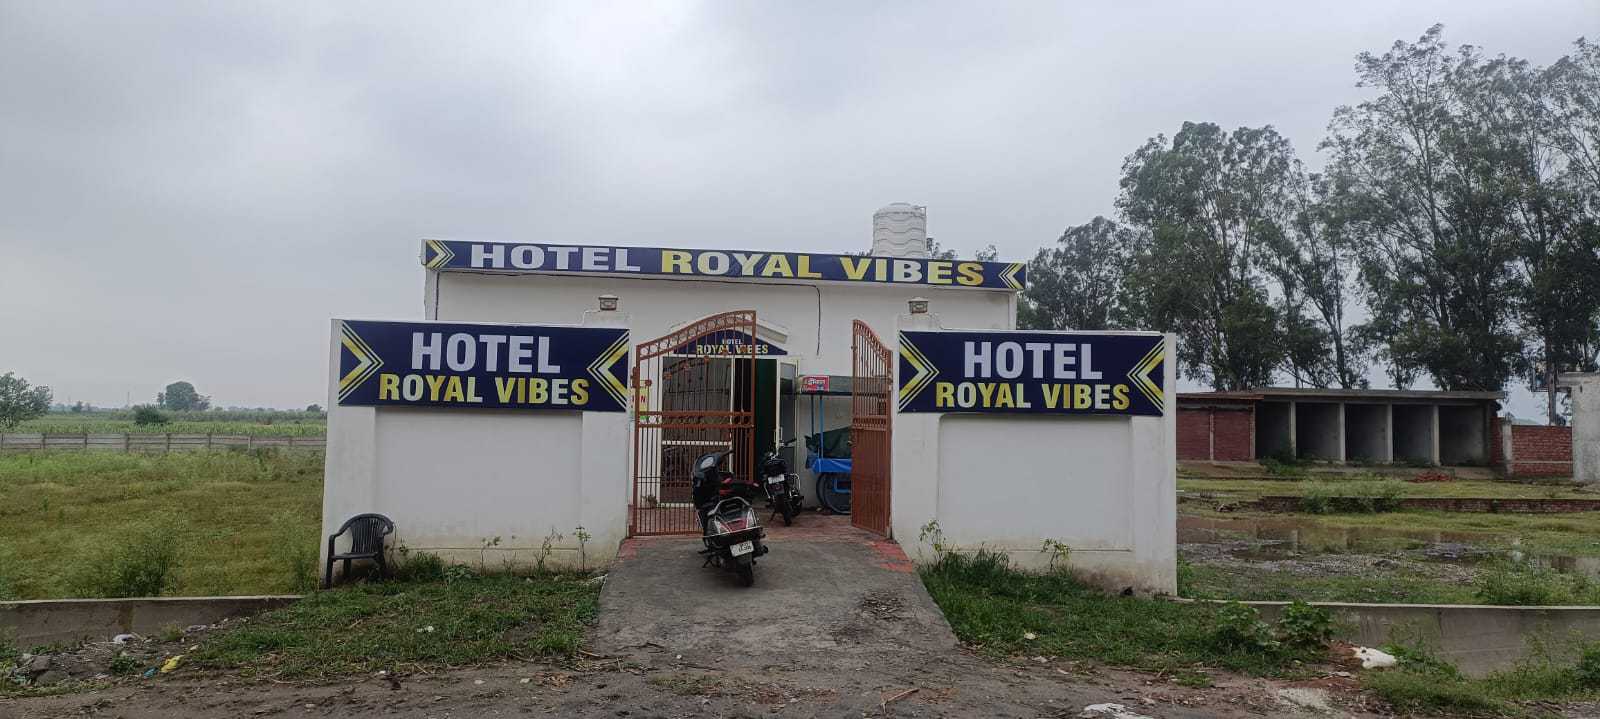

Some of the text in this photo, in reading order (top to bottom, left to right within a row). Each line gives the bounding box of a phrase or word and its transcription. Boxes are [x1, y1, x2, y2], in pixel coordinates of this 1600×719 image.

[471, 244, 984, 286] HOTEL ROYAL VIBES
[411, 332, 560, 373] HOTEL
[696, 344, 769, 354] ROYAL VBES
[964, 341, 1102, 380] HOTEL
[379, 373, 590, 405] ROYAL VIBES
[935, 382, 1130, 410] ROYAL VIBES
